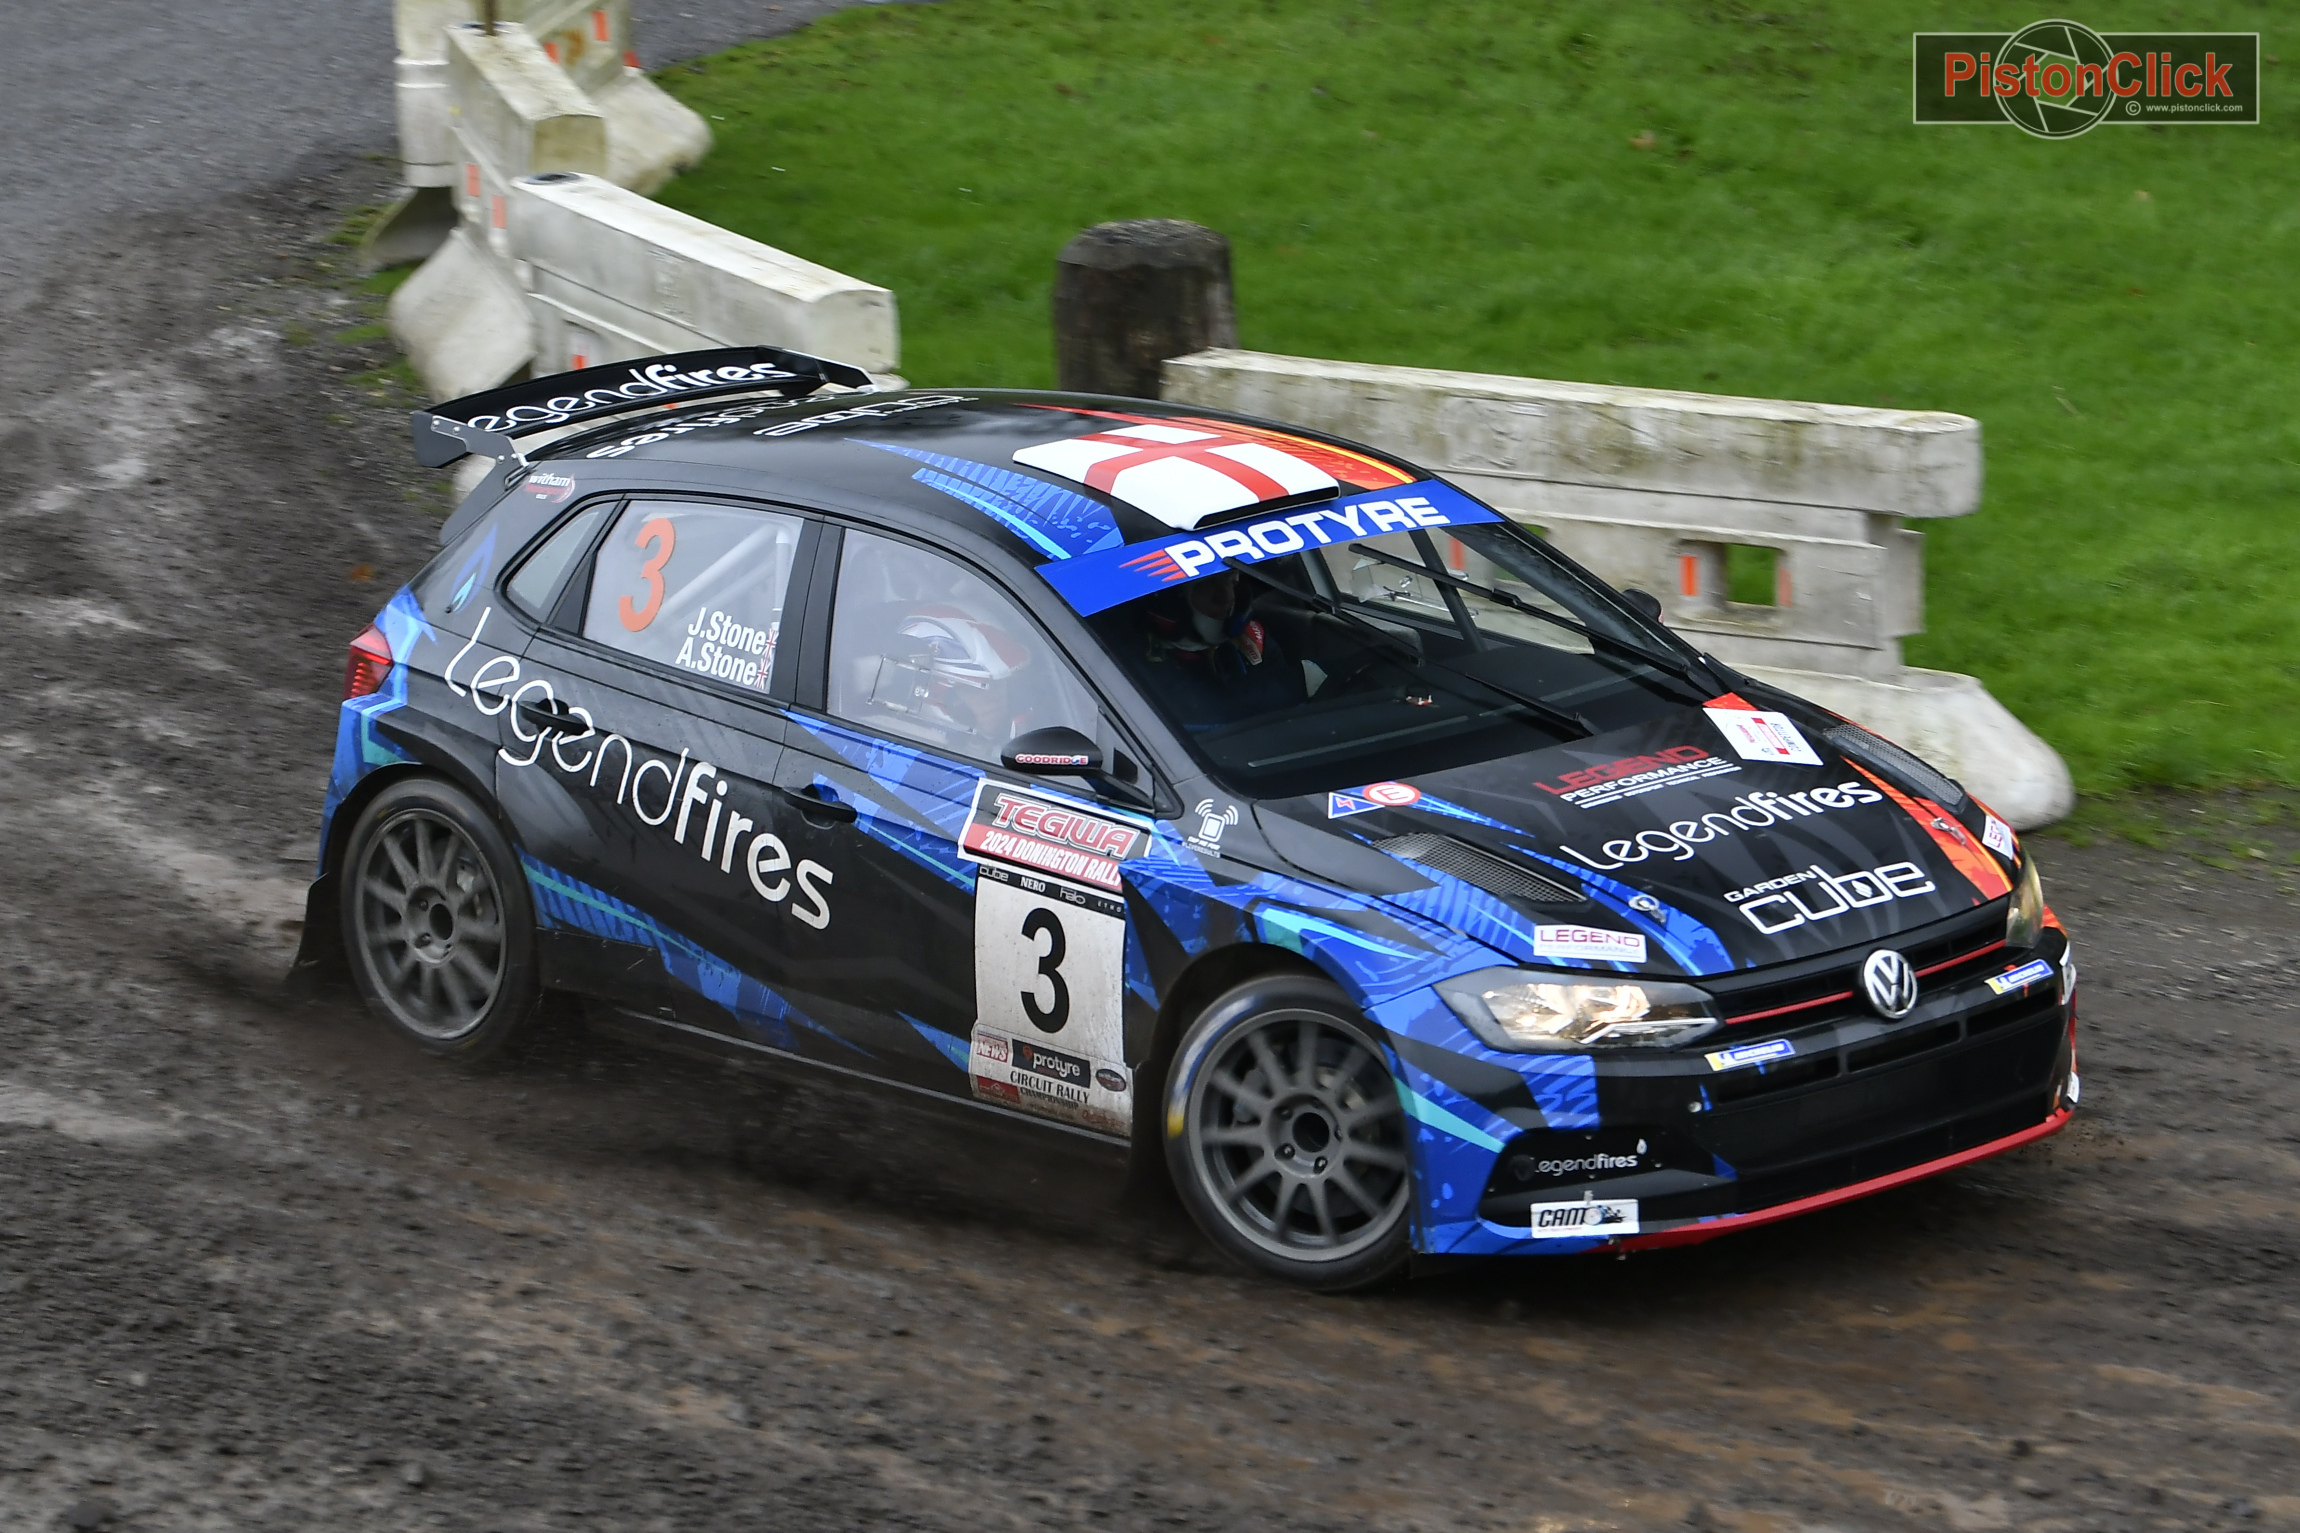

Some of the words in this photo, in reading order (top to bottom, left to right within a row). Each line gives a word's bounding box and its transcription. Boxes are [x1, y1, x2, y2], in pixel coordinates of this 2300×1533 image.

[467, 363, 796, 432] egendfires
[529, 473, 571, 487] witham
[1164, 497, 1450, 578] PROTYRE
[619, 518, 676, 632] 3
[687, 607, 767, 655] J.Stone
[675, 636, 758, 686] A.Stone
[445, 607, 833, 930] Legendfires
[1016, 754, 1088, 765] GOODRIDGE
[1534, 745, 1709, 795] LEGEND
[1560, 757, 1727, 802] PERFORMANCE
[995, 795, 1139, 858] TEGIWA
[1559, 781, 1883, 870] Legendfires
[979, 866, 1009, 882] cube
[980, 831, 1015, 856] 2024
[1012, 839, 1089, 877] DONINGTON
[1020, 876, 1046, 893] NERO
[1060, 886, 1086, 905] halo
[1724, 870, 1818, 902] GARDEN
[1739, 862, 1936, 935] cube
[1541, 929, 1640, 947] LEGEND
[1020, 907, 1070, 1034] 3
[977, 1040, 1008, 1061] NEWS
[1033, 1052, 1081, 1078] protyre
[1010, 1070, 1053, 1094] CIRCUIT
[1056, 1084, 1090, 1104] RALLY
